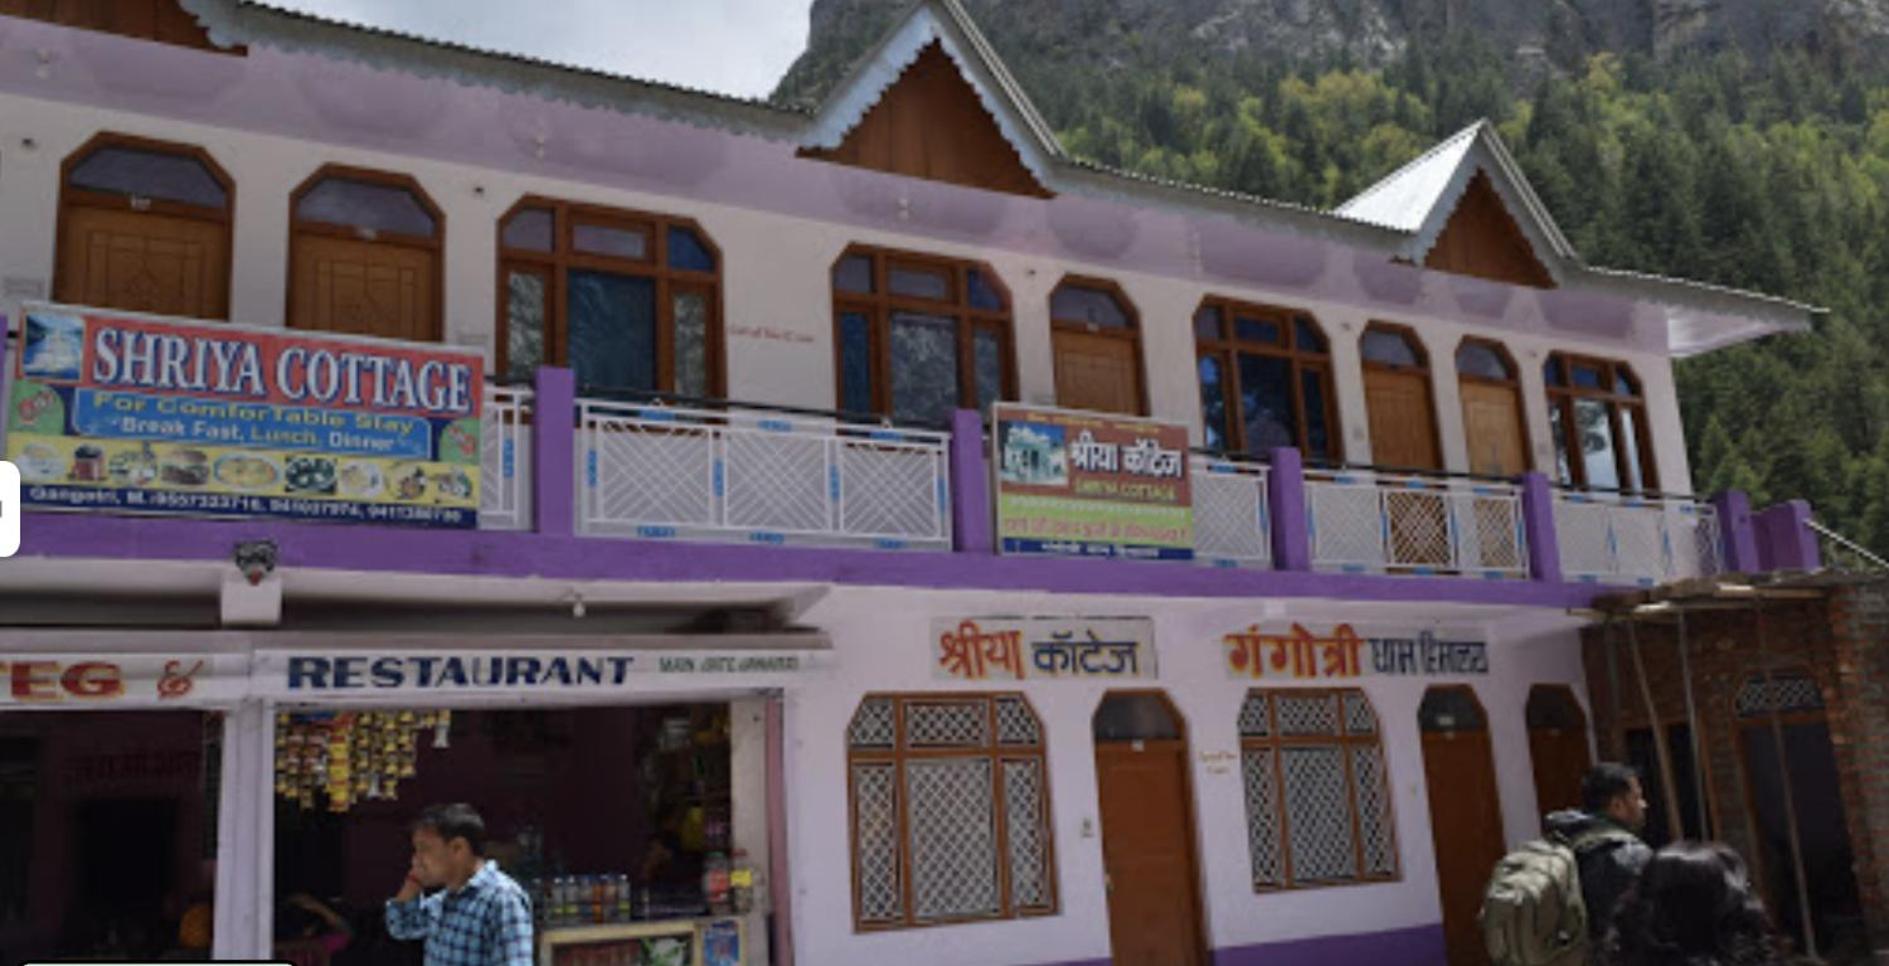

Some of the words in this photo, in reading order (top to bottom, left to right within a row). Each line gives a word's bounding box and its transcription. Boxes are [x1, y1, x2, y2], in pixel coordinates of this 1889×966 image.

[94, 326, 267, 396] SHRIYA
[276, 346, 473, 414] COTTAGE
[94, 392, 146, 411] For
[356, 413, 414, 436] Stay
[122, 416, 185, 435] Break
[288, 656, 635, 689] RESTAURANT
[939, 619, 1026, 680] श्रीया
[1030, 629, 1139, 675] कॉटेज
[1222, 621, 1365, 680] गंगोत्री
